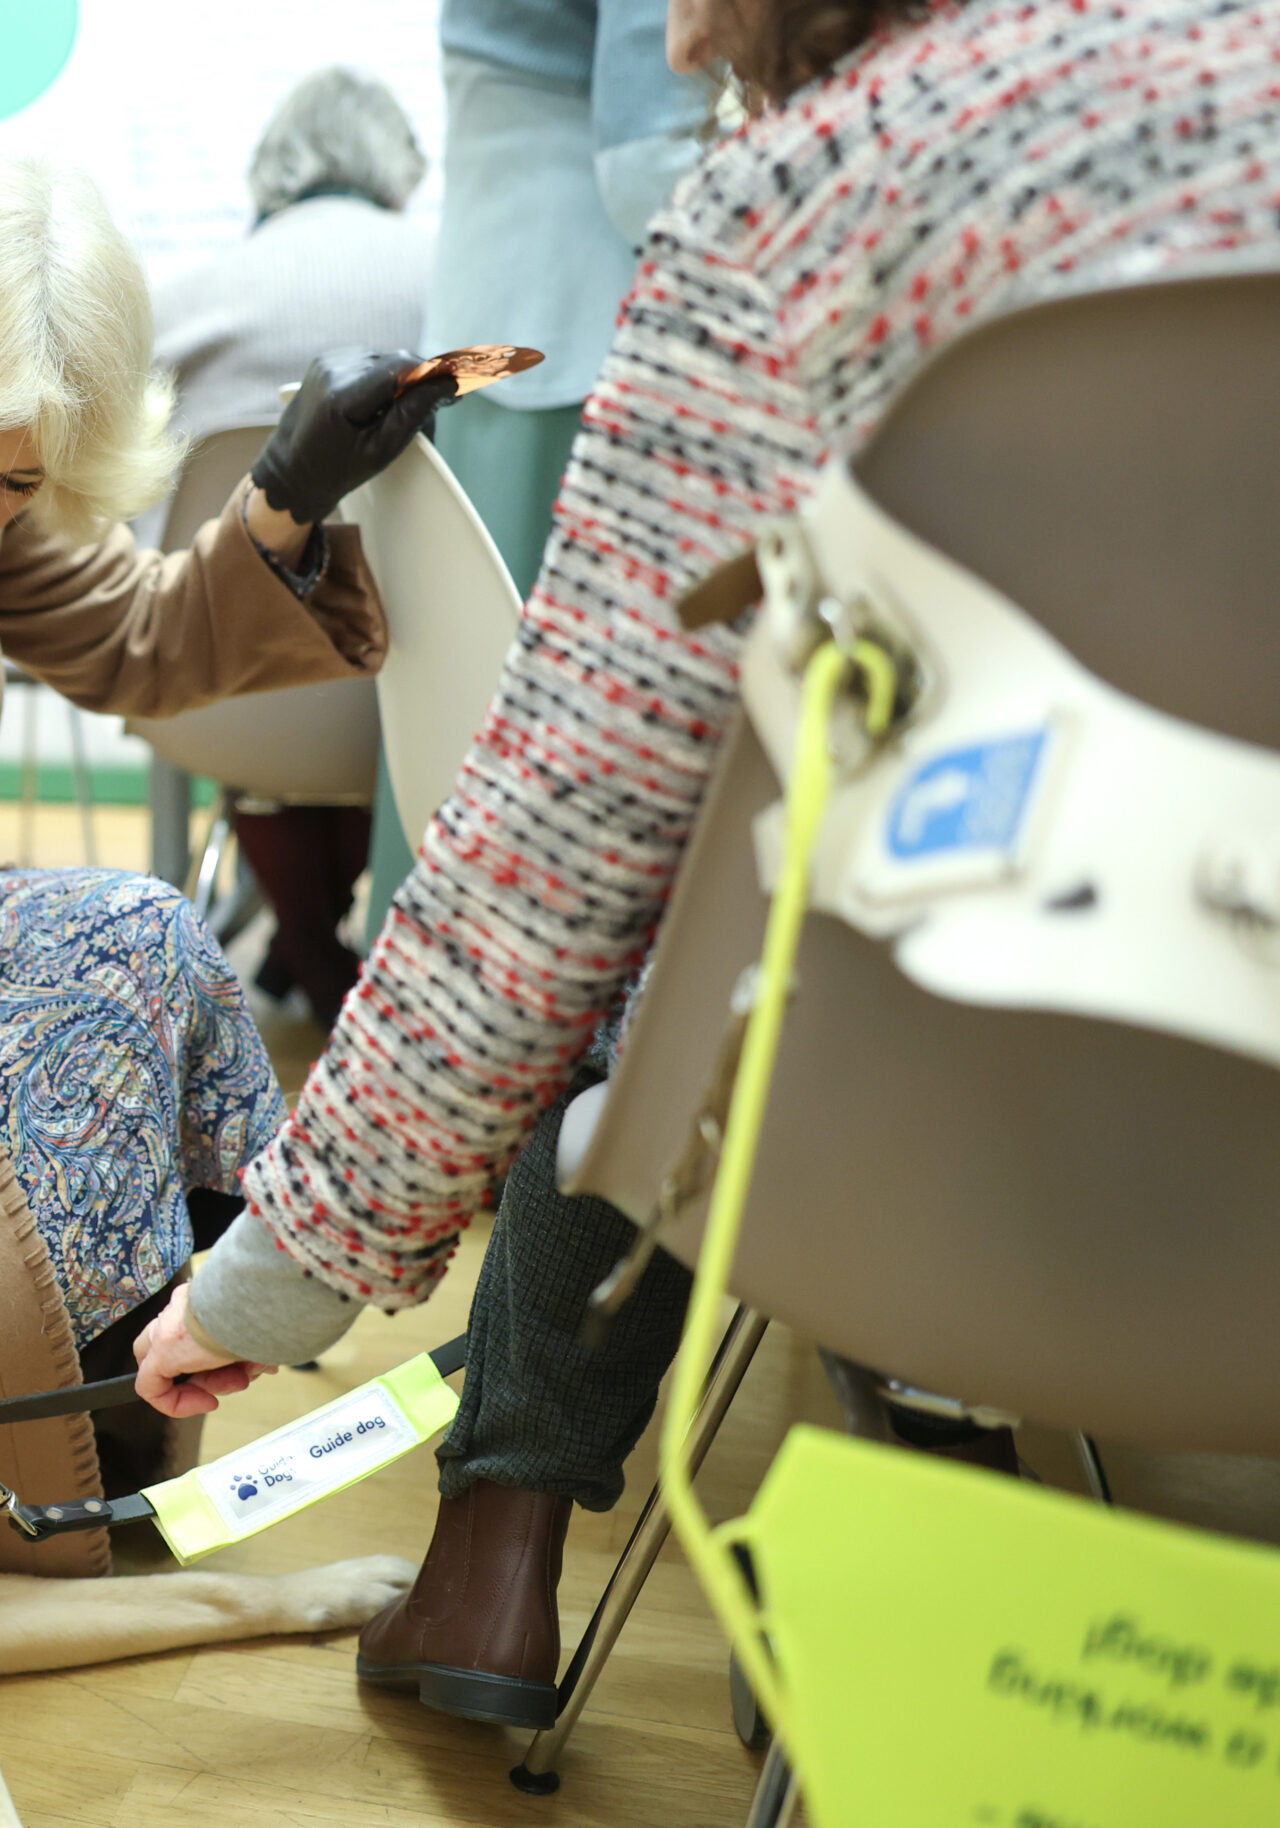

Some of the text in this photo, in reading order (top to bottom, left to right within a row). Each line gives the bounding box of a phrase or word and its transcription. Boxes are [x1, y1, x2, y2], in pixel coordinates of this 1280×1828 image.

[309, 1416, 385, 1458] Guide dog
[258, 1455, 294, 1476] Guid
[264, 1467, 297, 1487] Dog
